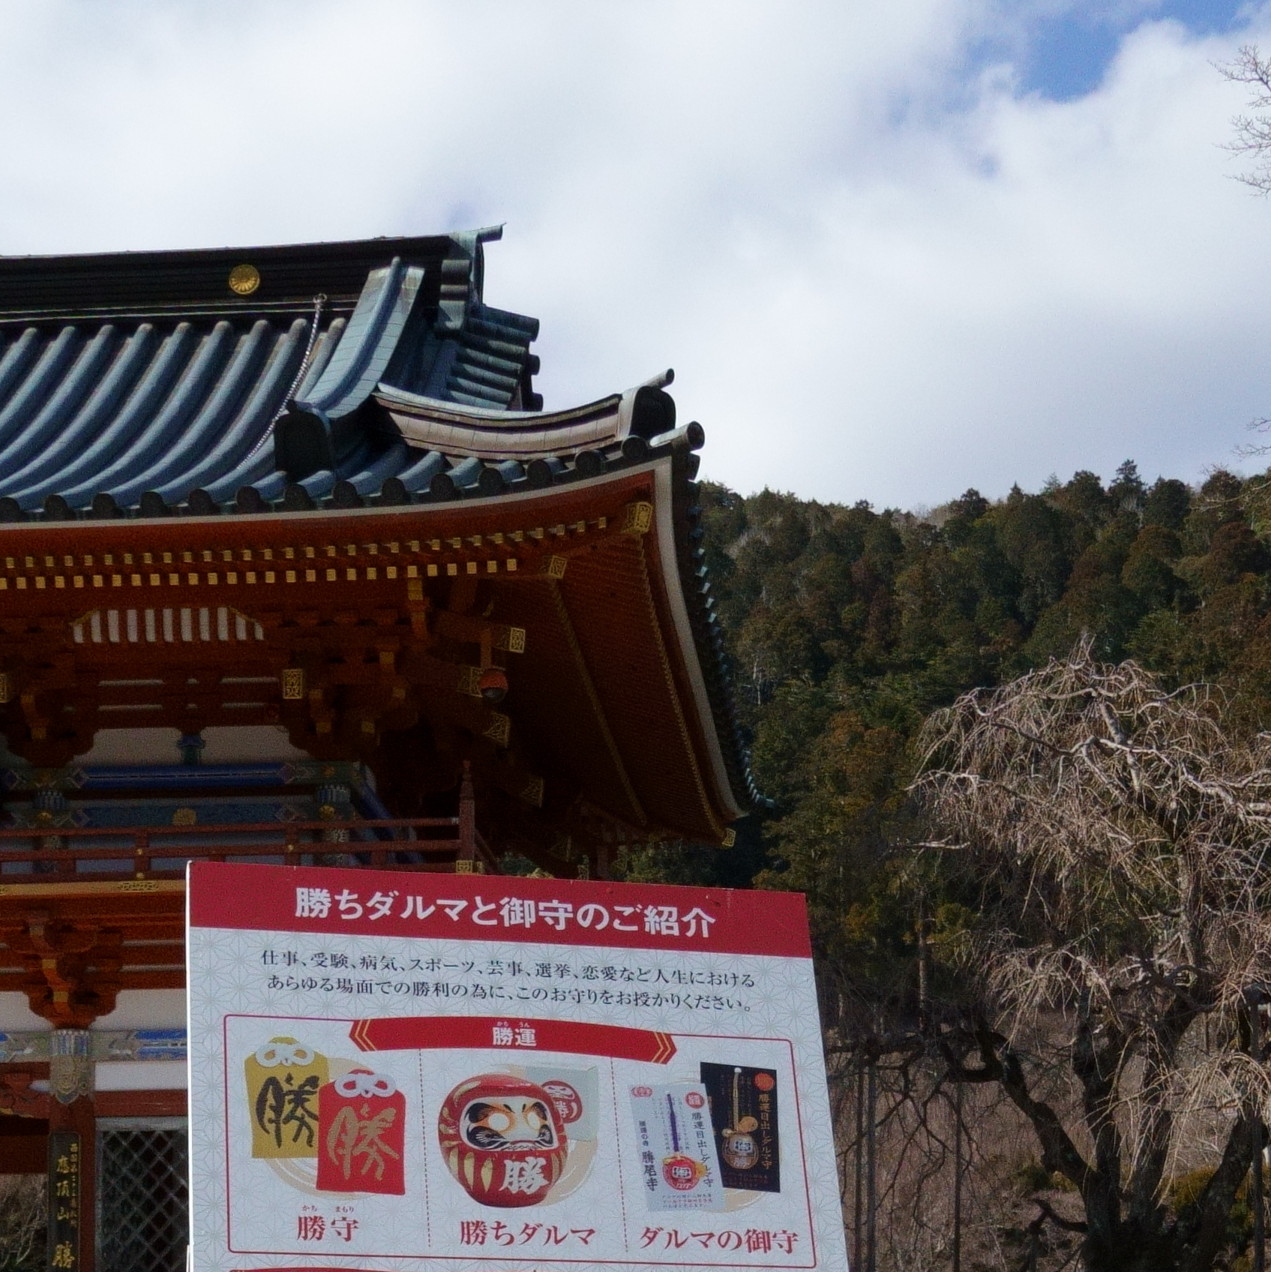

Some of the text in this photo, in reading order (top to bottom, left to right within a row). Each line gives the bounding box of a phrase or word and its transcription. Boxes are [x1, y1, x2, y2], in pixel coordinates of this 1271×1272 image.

[295, 887, 715, 939] 勝ちダルマと御守のご紹介
[261, 950, 755, 988] 仕事、受験、病気、スポーツ、芸事、選挙、恋愛など人生における
[267, 974, 751, 1013] あらゆる場面での勝利の為に、このお守りをお授かりください。
[492, 1026, 537, 1047] 勝運
[327, 1103, 401, 1180] 勝
[499, 1157, 550, 1195] 勝
[297, 1215, 359, 1242] 勝守
[460, 1220, 596, 1247] 勝ちダルマ
[640, 1226, 799, 1257] ダルマの御守
